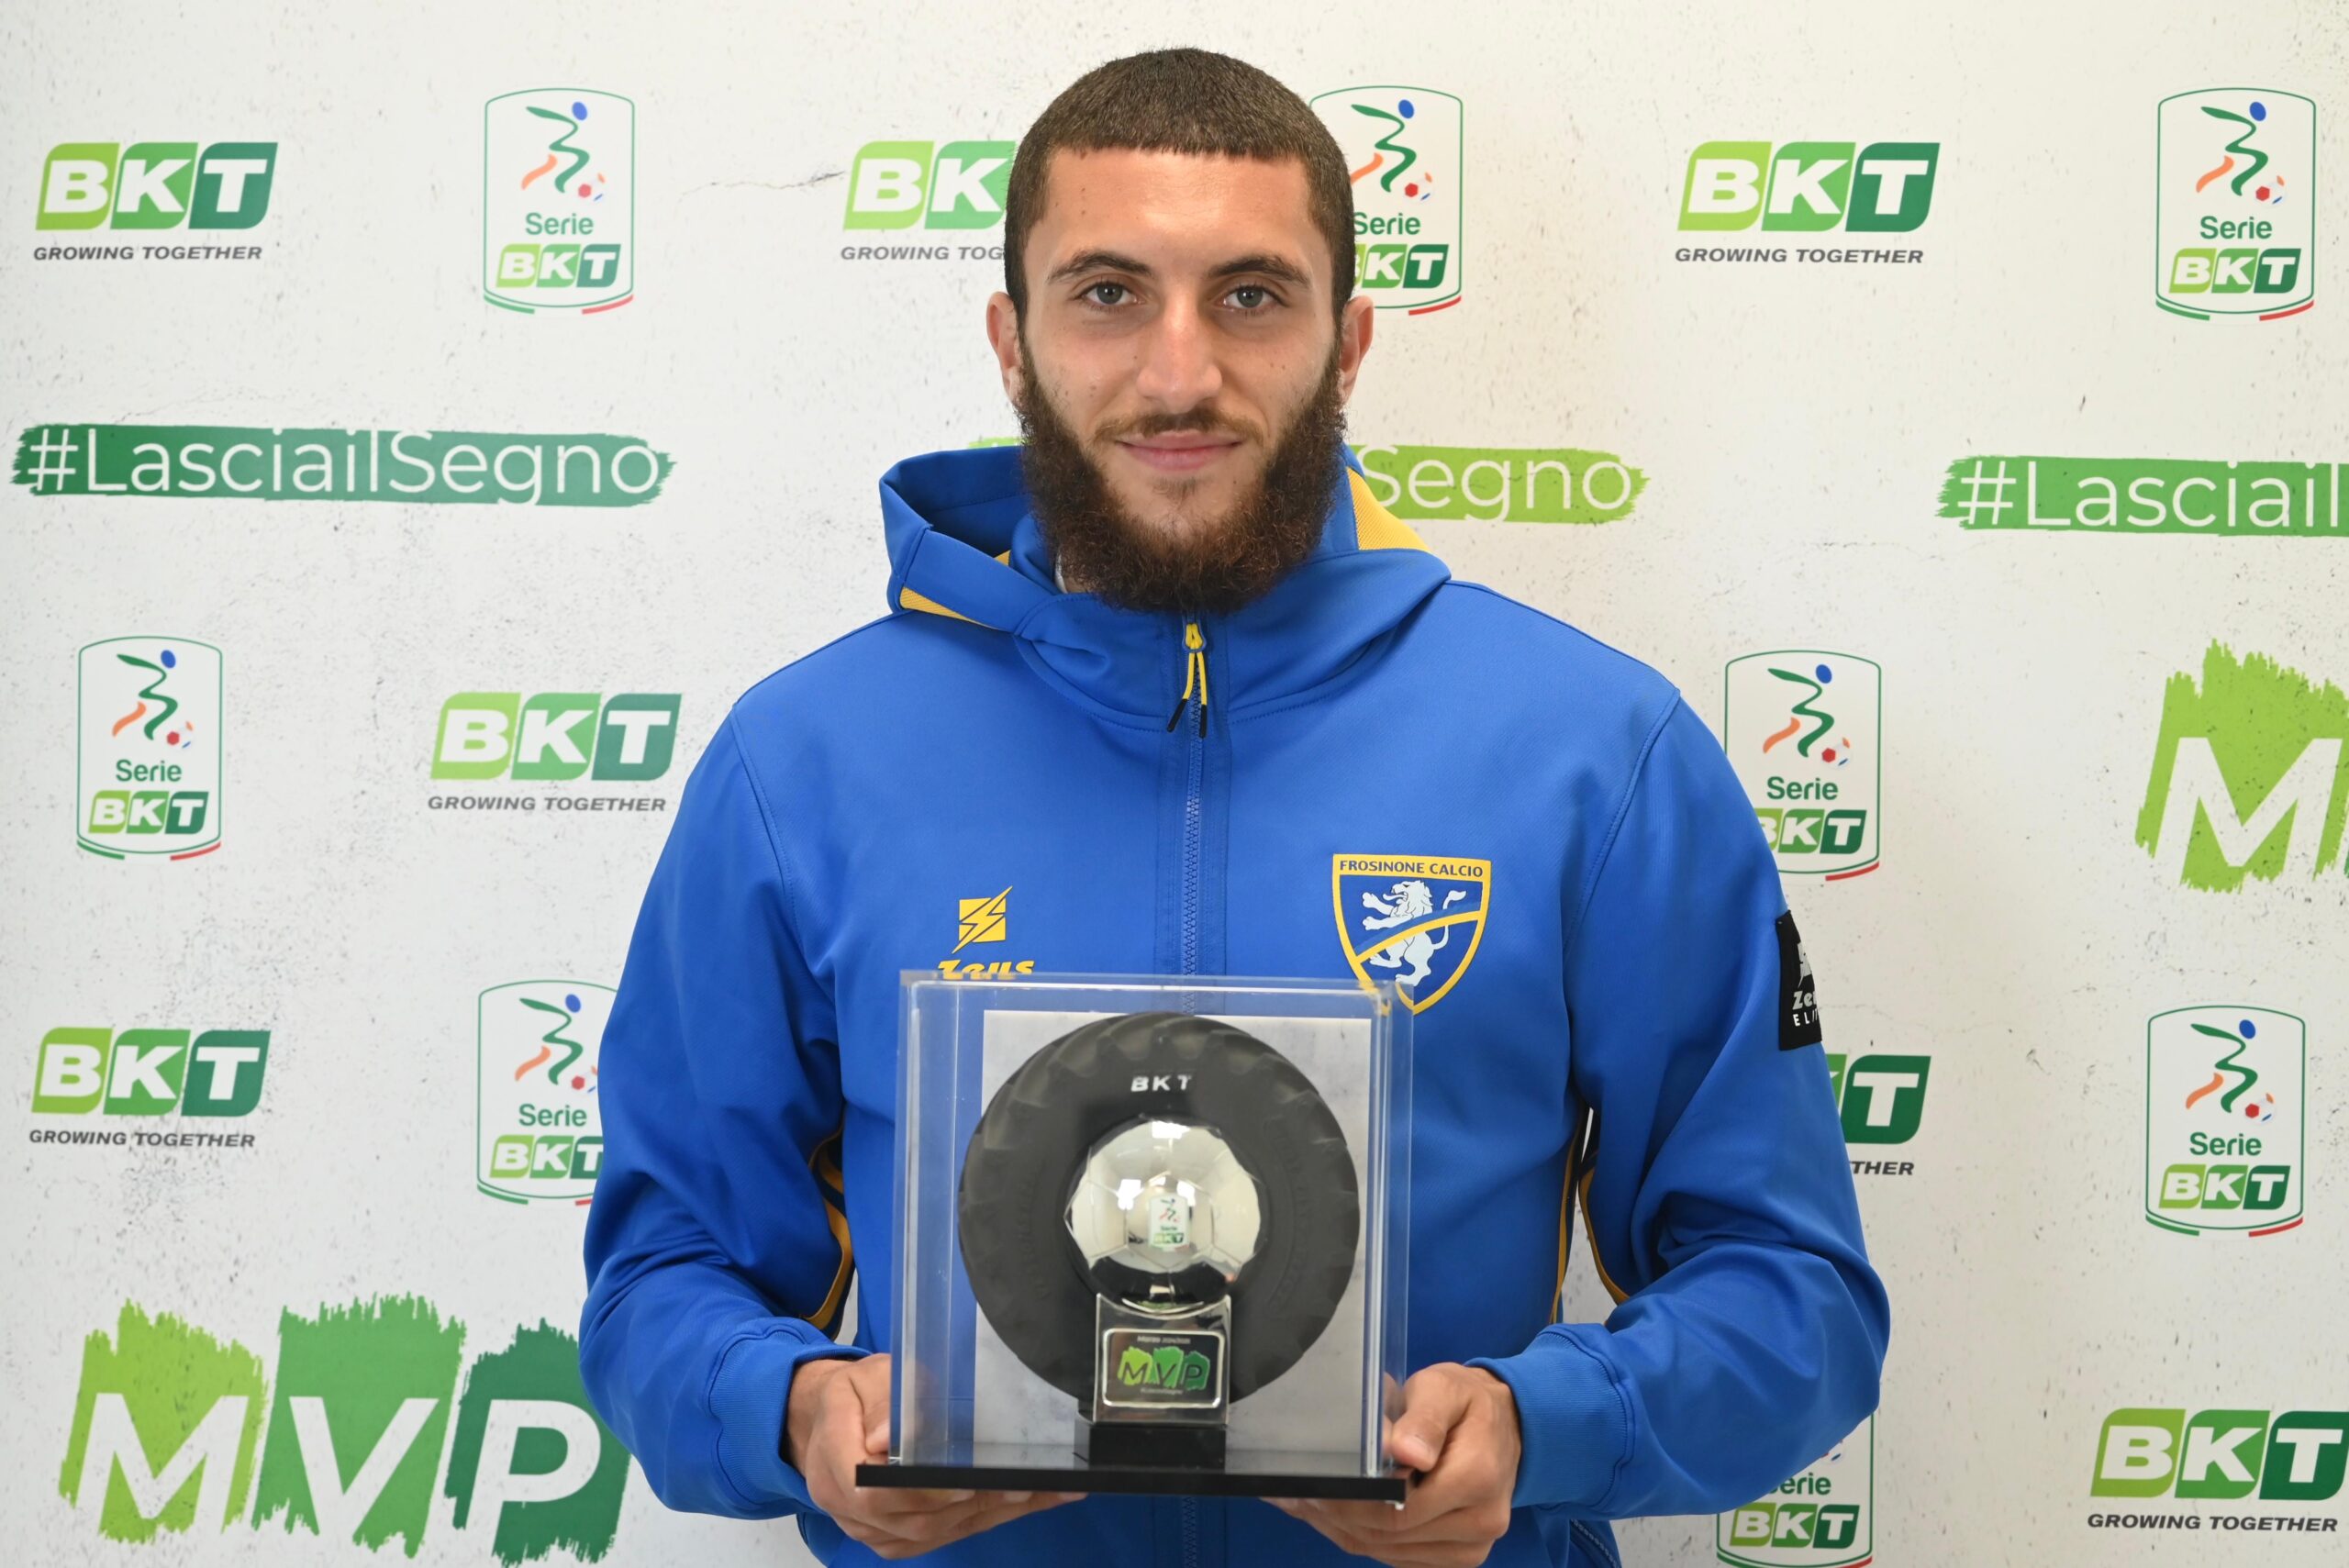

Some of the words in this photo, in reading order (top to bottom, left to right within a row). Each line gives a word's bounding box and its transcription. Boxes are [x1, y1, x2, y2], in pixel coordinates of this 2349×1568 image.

[42, 158, 270, 214] BKT
[851, 157, 1009, 213] BK
[1687, 158, 1931, 216] BKT
[524, 211, 595, 236] Serie
[1353, 211, 1421, 236] Serie
[2199, 215, 2274, 239] Serie
[32, 245, 135, 261] GROWING
[141, 245, 263, 261] TOGETHER
[498, 250, 618, 281] BKT
[841, 246, 950, 261] GROWING
[958, 246, 1006, 261] TOG
[1354, 250, 1444, 281] KT
[1674, 247, 1788, 263] GROWING
[1794, 248, 1924, 264] TOGETHER
[2173, 255, 2299, 286] BKT
[28, 426, 661, 505] #LasciailSegno
[1357, 444, 1632, 523] Segno
[1957, 458, 2340, 528] #Lasciail
[438, 707, 674, 765] BKT
[115, 758, 183, 784] Serie
[1766, 775, 1839, 801] Serie
[92, 796, 206, 828] BKT
[427, 795, 538, 812] GROWING
[543, 796, 668, 813] TOGETHER
[2145, 736, 2343, 884] M
[1339, 859, 1425, 874] FROSINONE
[1429, 862, 1485, 878] CALCIO
[1792, 989, 1818, 1011] Ze
[38, 1043, 262, 1103] BKT
[1130, 1073, 1193, 1093] BKT
[518, 1103, 588, 1128] Serie
[28, 1129, 128, 1147] GROWING
[133, 1131, 256, 1150] TOGETHER
[2188, 1131, 2263, 1157] Serie
[492, 1141, 605, 1173] BKT
[1850, 1160, 1916, 1176] THER
[2161, 1171, 2288, 1205] BKT
[1121, 1361, 1204, 1386] MVP
[2099, 1424, 2344, 1485] BKT
[72, 1391, 603, 1551] MVP
[1770, 1471, 1832, 1496] erie
[1733, 1509, 1855, 1541] BKT
[2086, 1512, 2201, 1531] GROWING
[2209, 1515, 2338, 1533] TOGETHER
